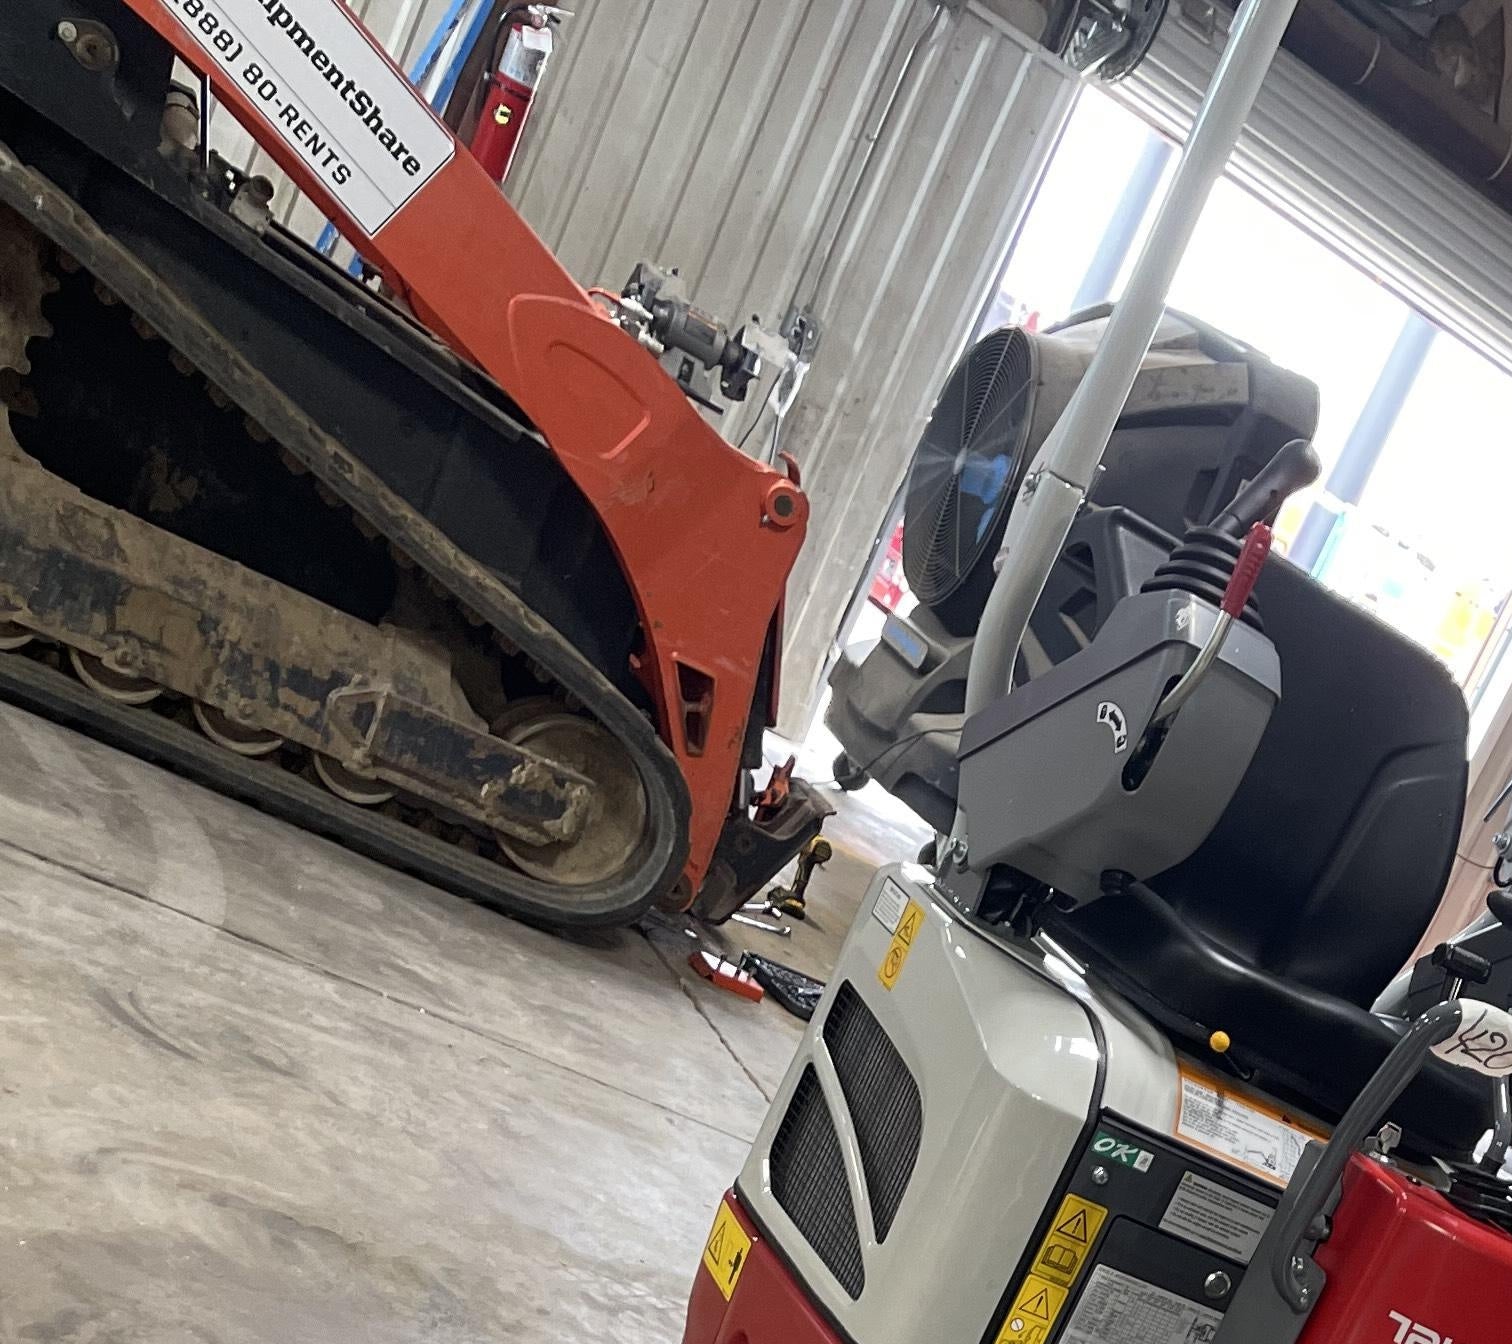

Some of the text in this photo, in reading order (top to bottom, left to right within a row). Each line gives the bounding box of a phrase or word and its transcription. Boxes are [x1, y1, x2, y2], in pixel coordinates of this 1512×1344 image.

[172, 0, 353, 186] 888) 80-RENTS
[257, 0, 421, 176] ipmentShare
[1093, 1137, 1139, 1162] OK
